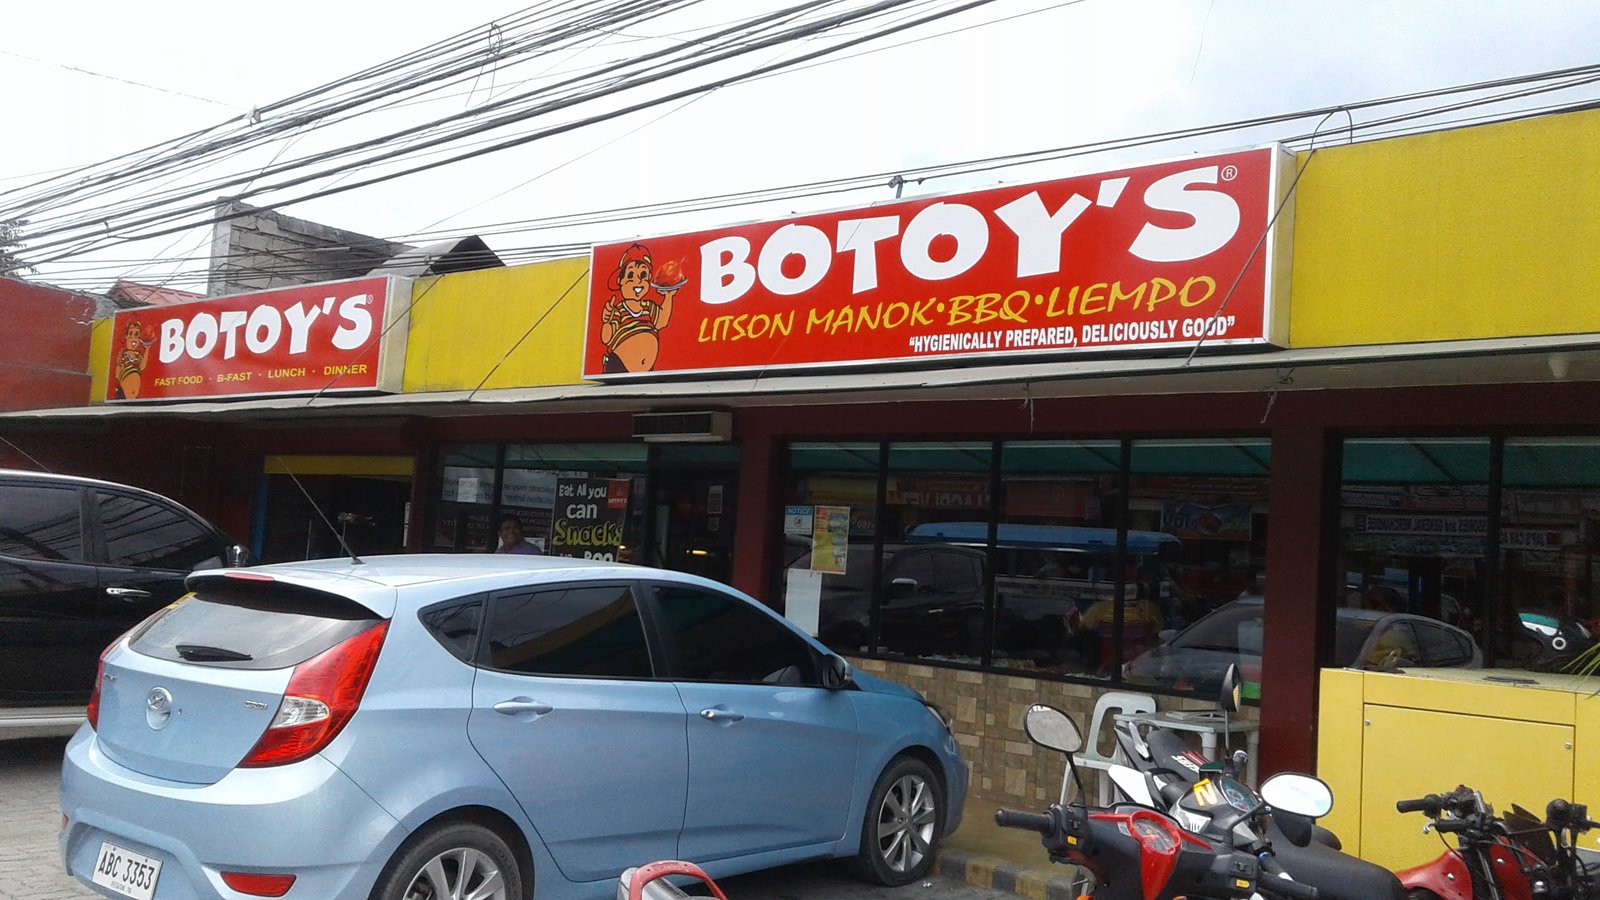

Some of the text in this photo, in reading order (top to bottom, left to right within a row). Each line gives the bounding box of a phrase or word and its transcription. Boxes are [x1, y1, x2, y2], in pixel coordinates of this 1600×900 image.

[700, 166, 1241, 305] BOTOY'S
[159, 294, 374, 364] BOTOY'S
[698, 310, 795, 343] LITSON
[1006, 326, 1078, 348] PREPARED,
[1082, 319, 1178, 343] DELICIOUSLY
[154, 364, 368, 387] FAST FOOD B-FAST LUNCH DINNER
[559, 484, 575, 497] Eat
[576, 483, 587, 496] All
[588, 486, 608, 500] you
[566, 503, 598, 519] can
[552, 518, 623, 547] Snacks
[98, 851, 155, 890] ABC 3353
